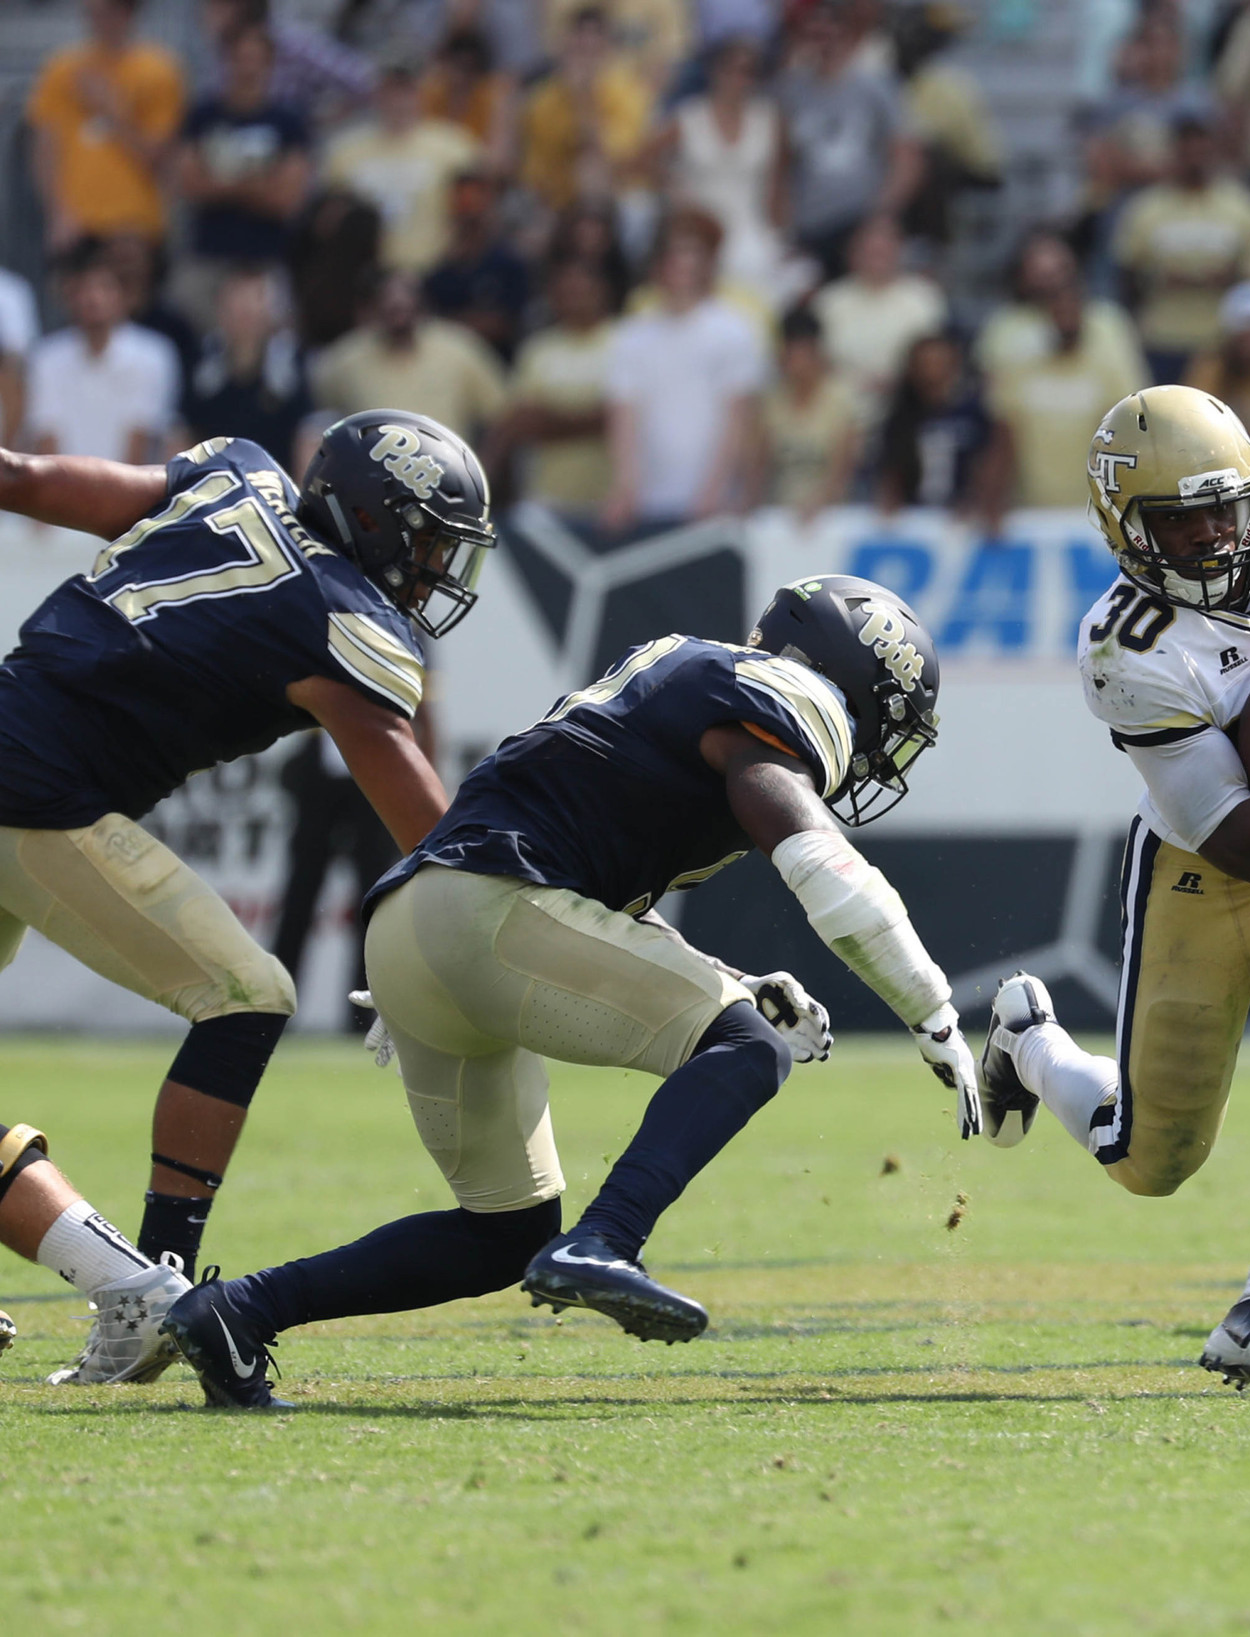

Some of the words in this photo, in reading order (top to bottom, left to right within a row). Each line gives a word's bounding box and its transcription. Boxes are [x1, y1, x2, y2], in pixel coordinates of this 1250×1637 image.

[369, 424, 445, 499] Pitt
[1199, 475, 1226, 490] ACC
[85, 470, 303, 626] 17
[858, 601, 925, 692] Pitt
[1089, 583, 1177, 655] 30
[1220, 657, 1249, 676] RUSSELL
[1171, 885, 1205, 896] RUSSELL
